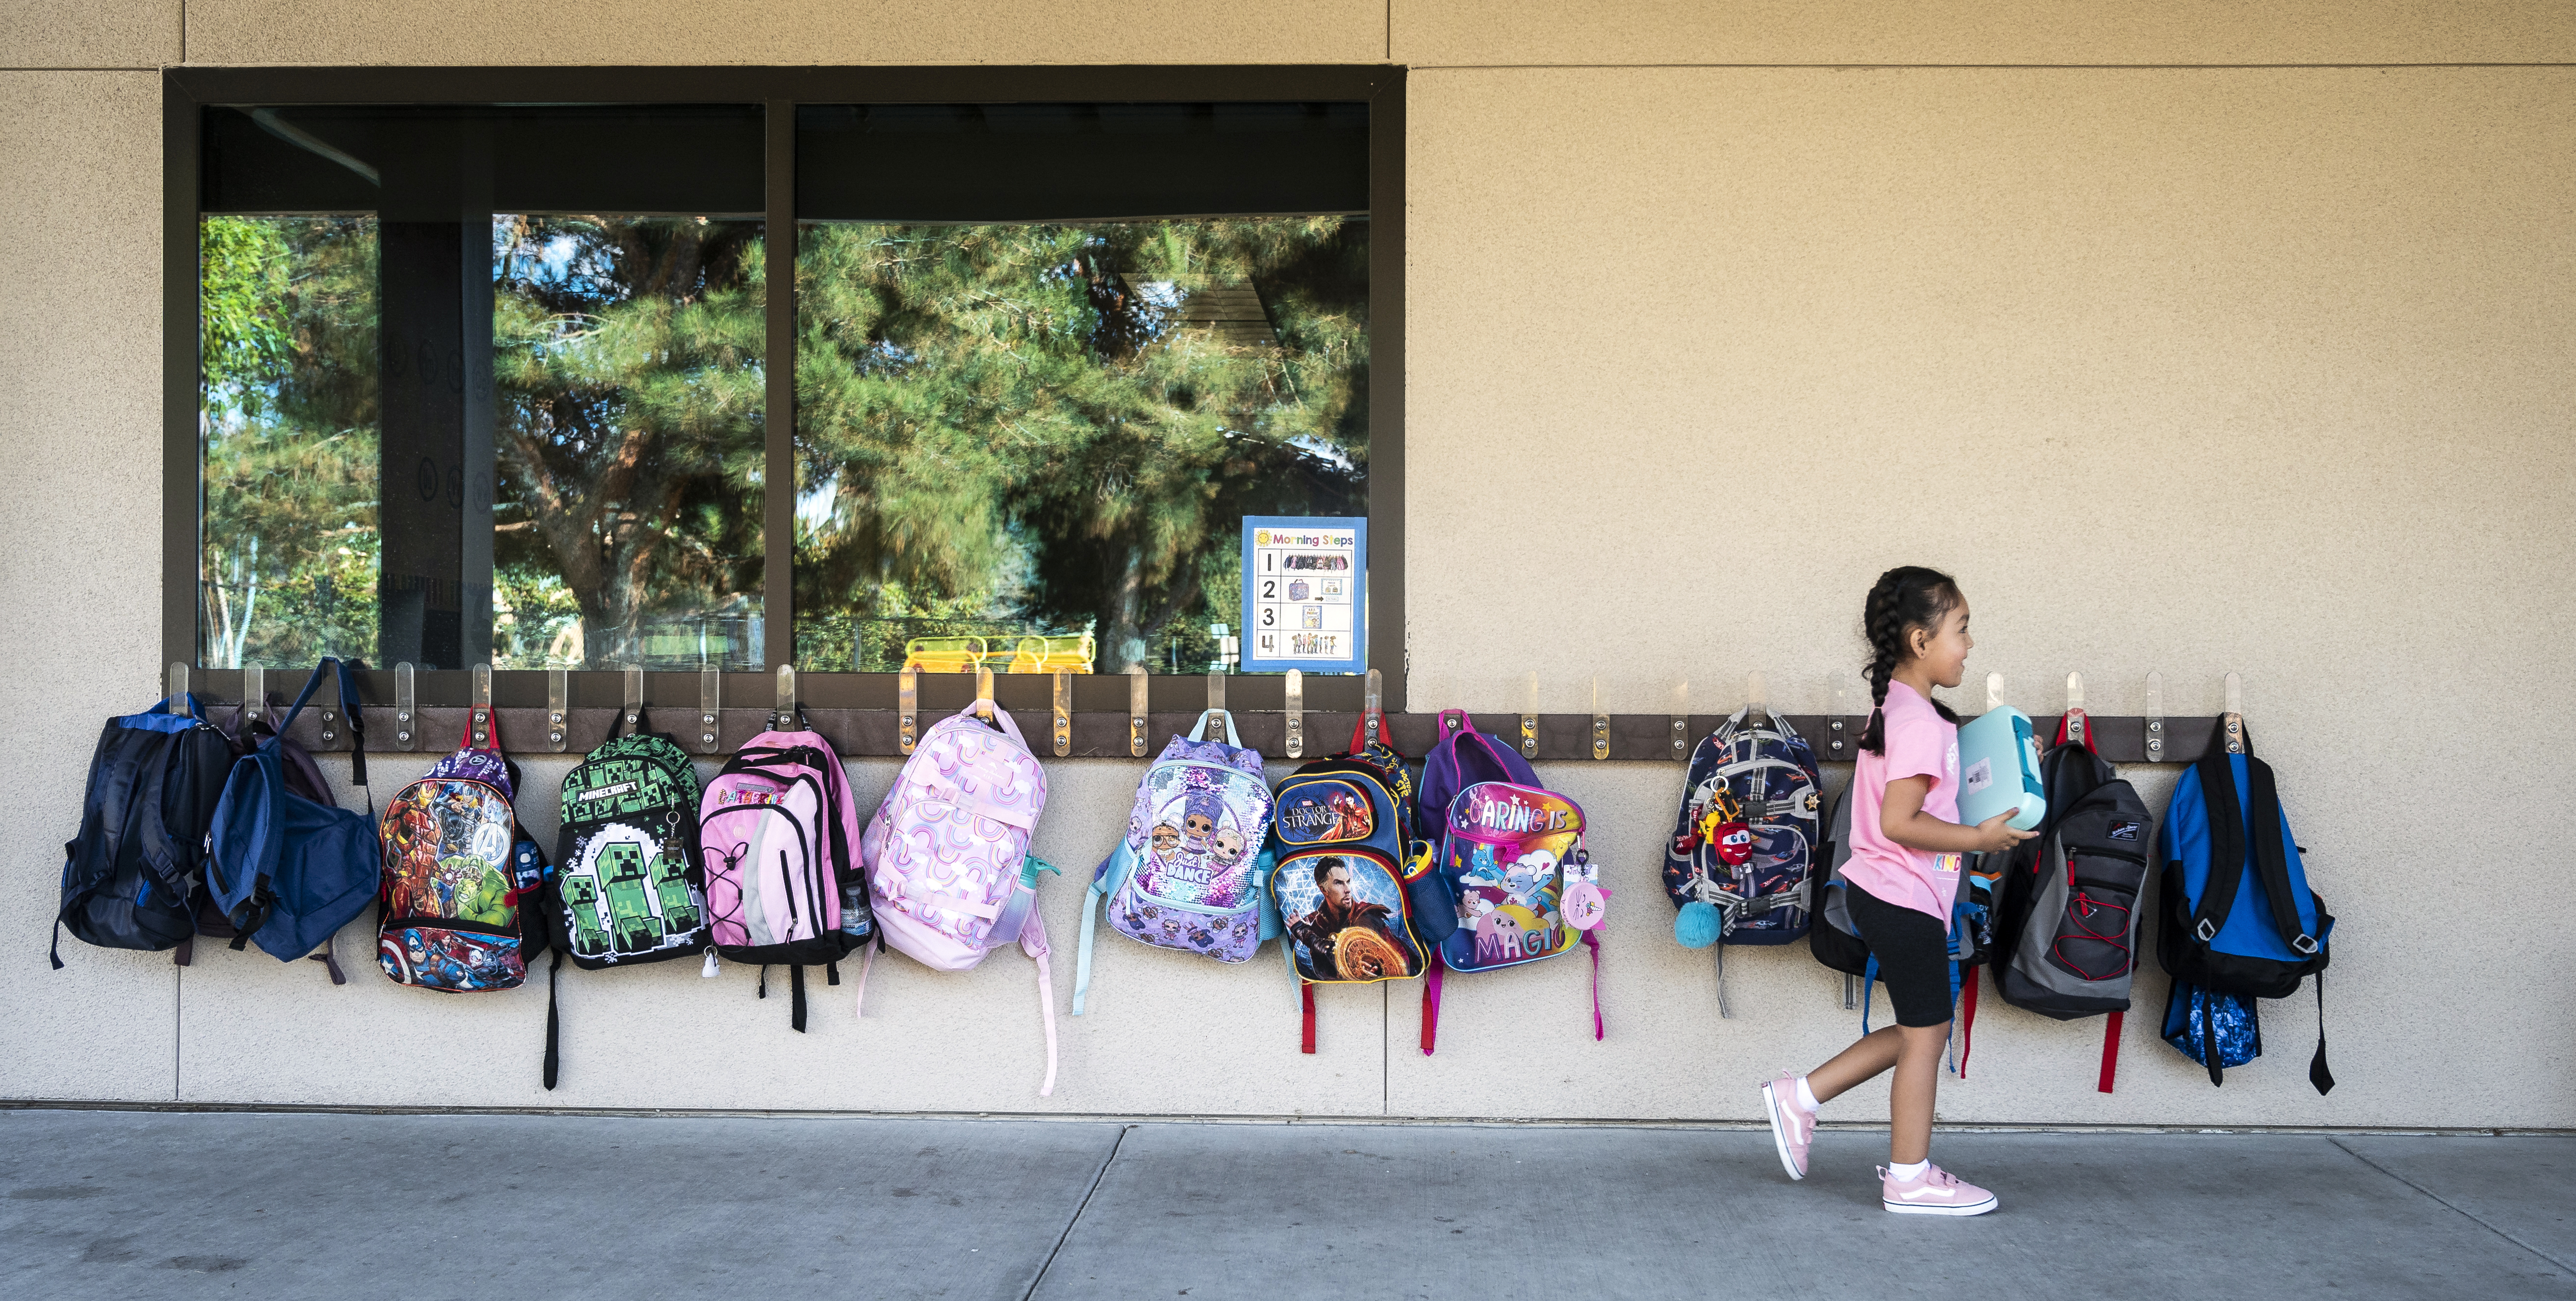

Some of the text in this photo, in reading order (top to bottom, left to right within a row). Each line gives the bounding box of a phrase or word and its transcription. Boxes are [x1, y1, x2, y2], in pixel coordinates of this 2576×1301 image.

[1273, 534, 1353, 547] Morning Steps
[1267, 554, 1271, 571] 1
[1263, 581, 1275, 598] 2
[1262, 608, 1274, 626] 3
[1262, 635, 1274, 652] 4
[578, 781, 638, 802] MINECRAFT
[718, 788, 785, 804] CATHERINE
[1292, 805, 1327, 816] DOCTOR
[1469, 798, 1569, 833] CARING IS
[1282, 812, 1340, 828] STRANGE
[1173, 852, 1199, 867] Just
[1167, 862, 1212, 885] DANCE
[1474, 923, 1566, 963] MAGIC
